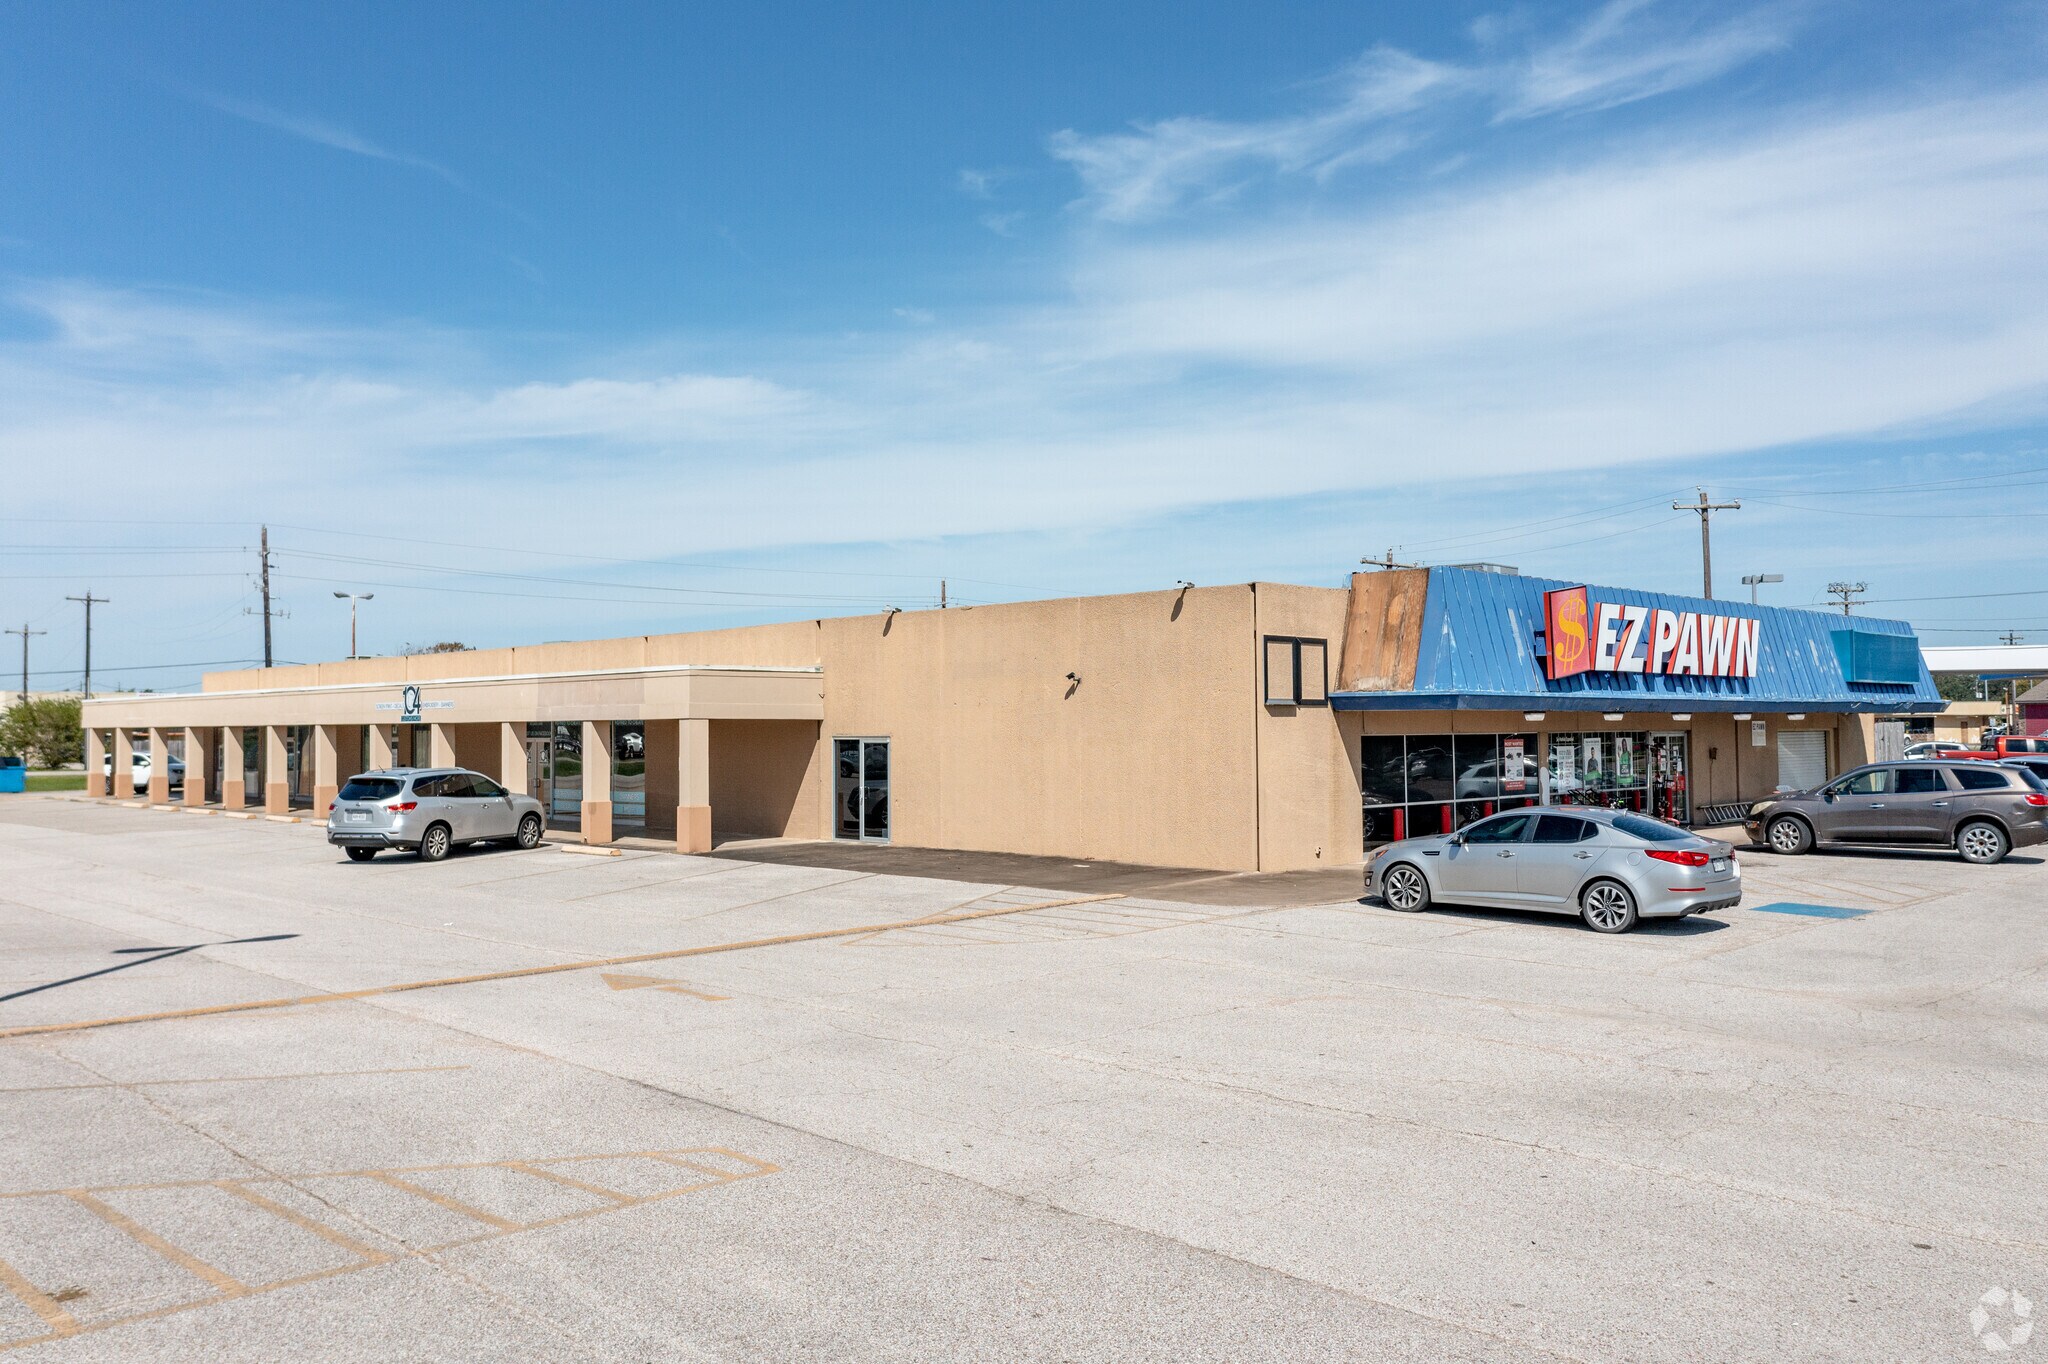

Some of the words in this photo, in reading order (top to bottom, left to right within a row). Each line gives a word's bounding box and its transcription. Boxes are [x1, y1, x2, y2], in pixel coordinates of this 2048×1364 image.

[1556, 592, 1586, 672] $
[1593, 602, 1649, 672] EZ
[1650, 608, 1760, 678] PAWN
